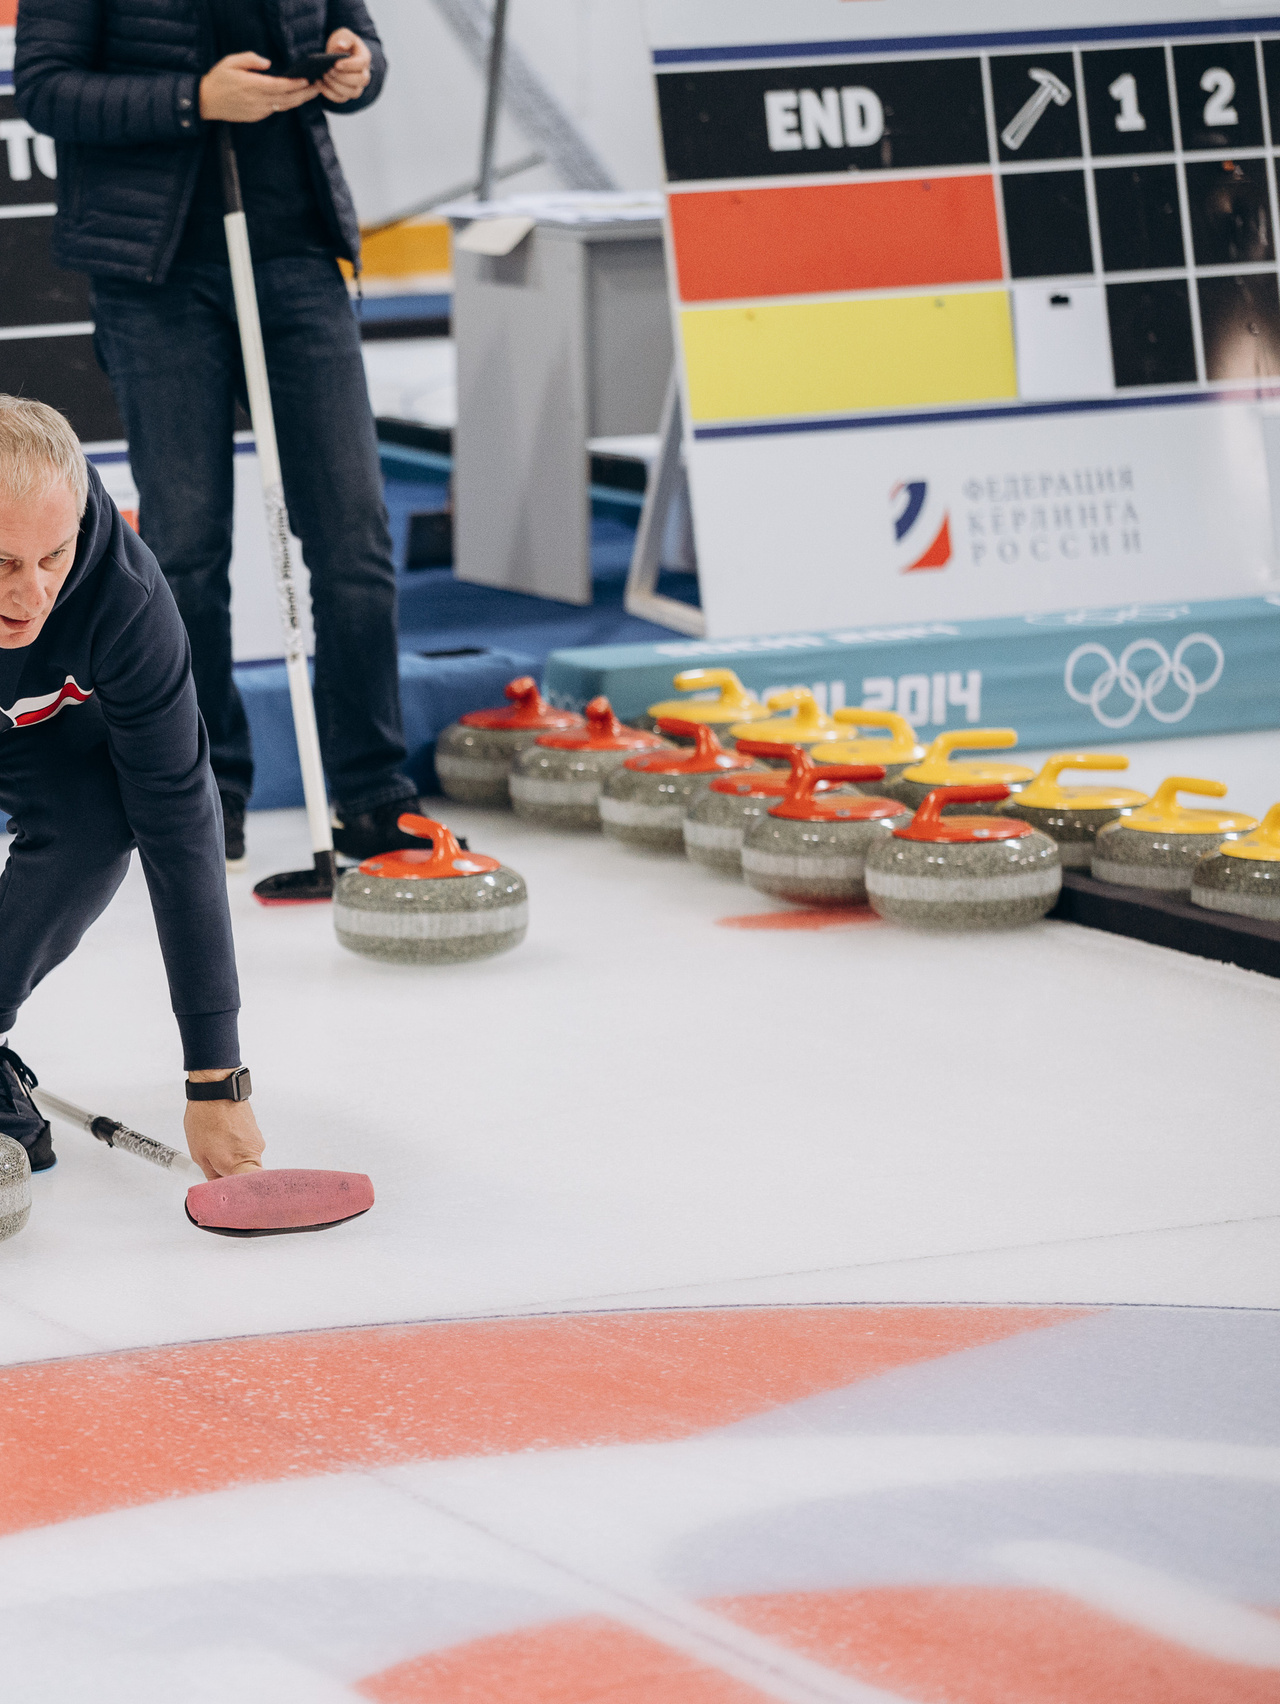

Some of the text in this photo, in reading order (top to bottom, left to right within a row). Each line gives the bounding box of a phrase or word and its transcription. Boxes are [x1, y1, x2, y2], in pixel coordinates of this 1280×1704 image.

[763, 68, 1238, 152] END 1 2
[962, 465, 1135, 501] ФЕДЕРАЦИЯ
[971, 528, 1142, 567] РОССИИ
[861, 670, 982, 730] 2014
